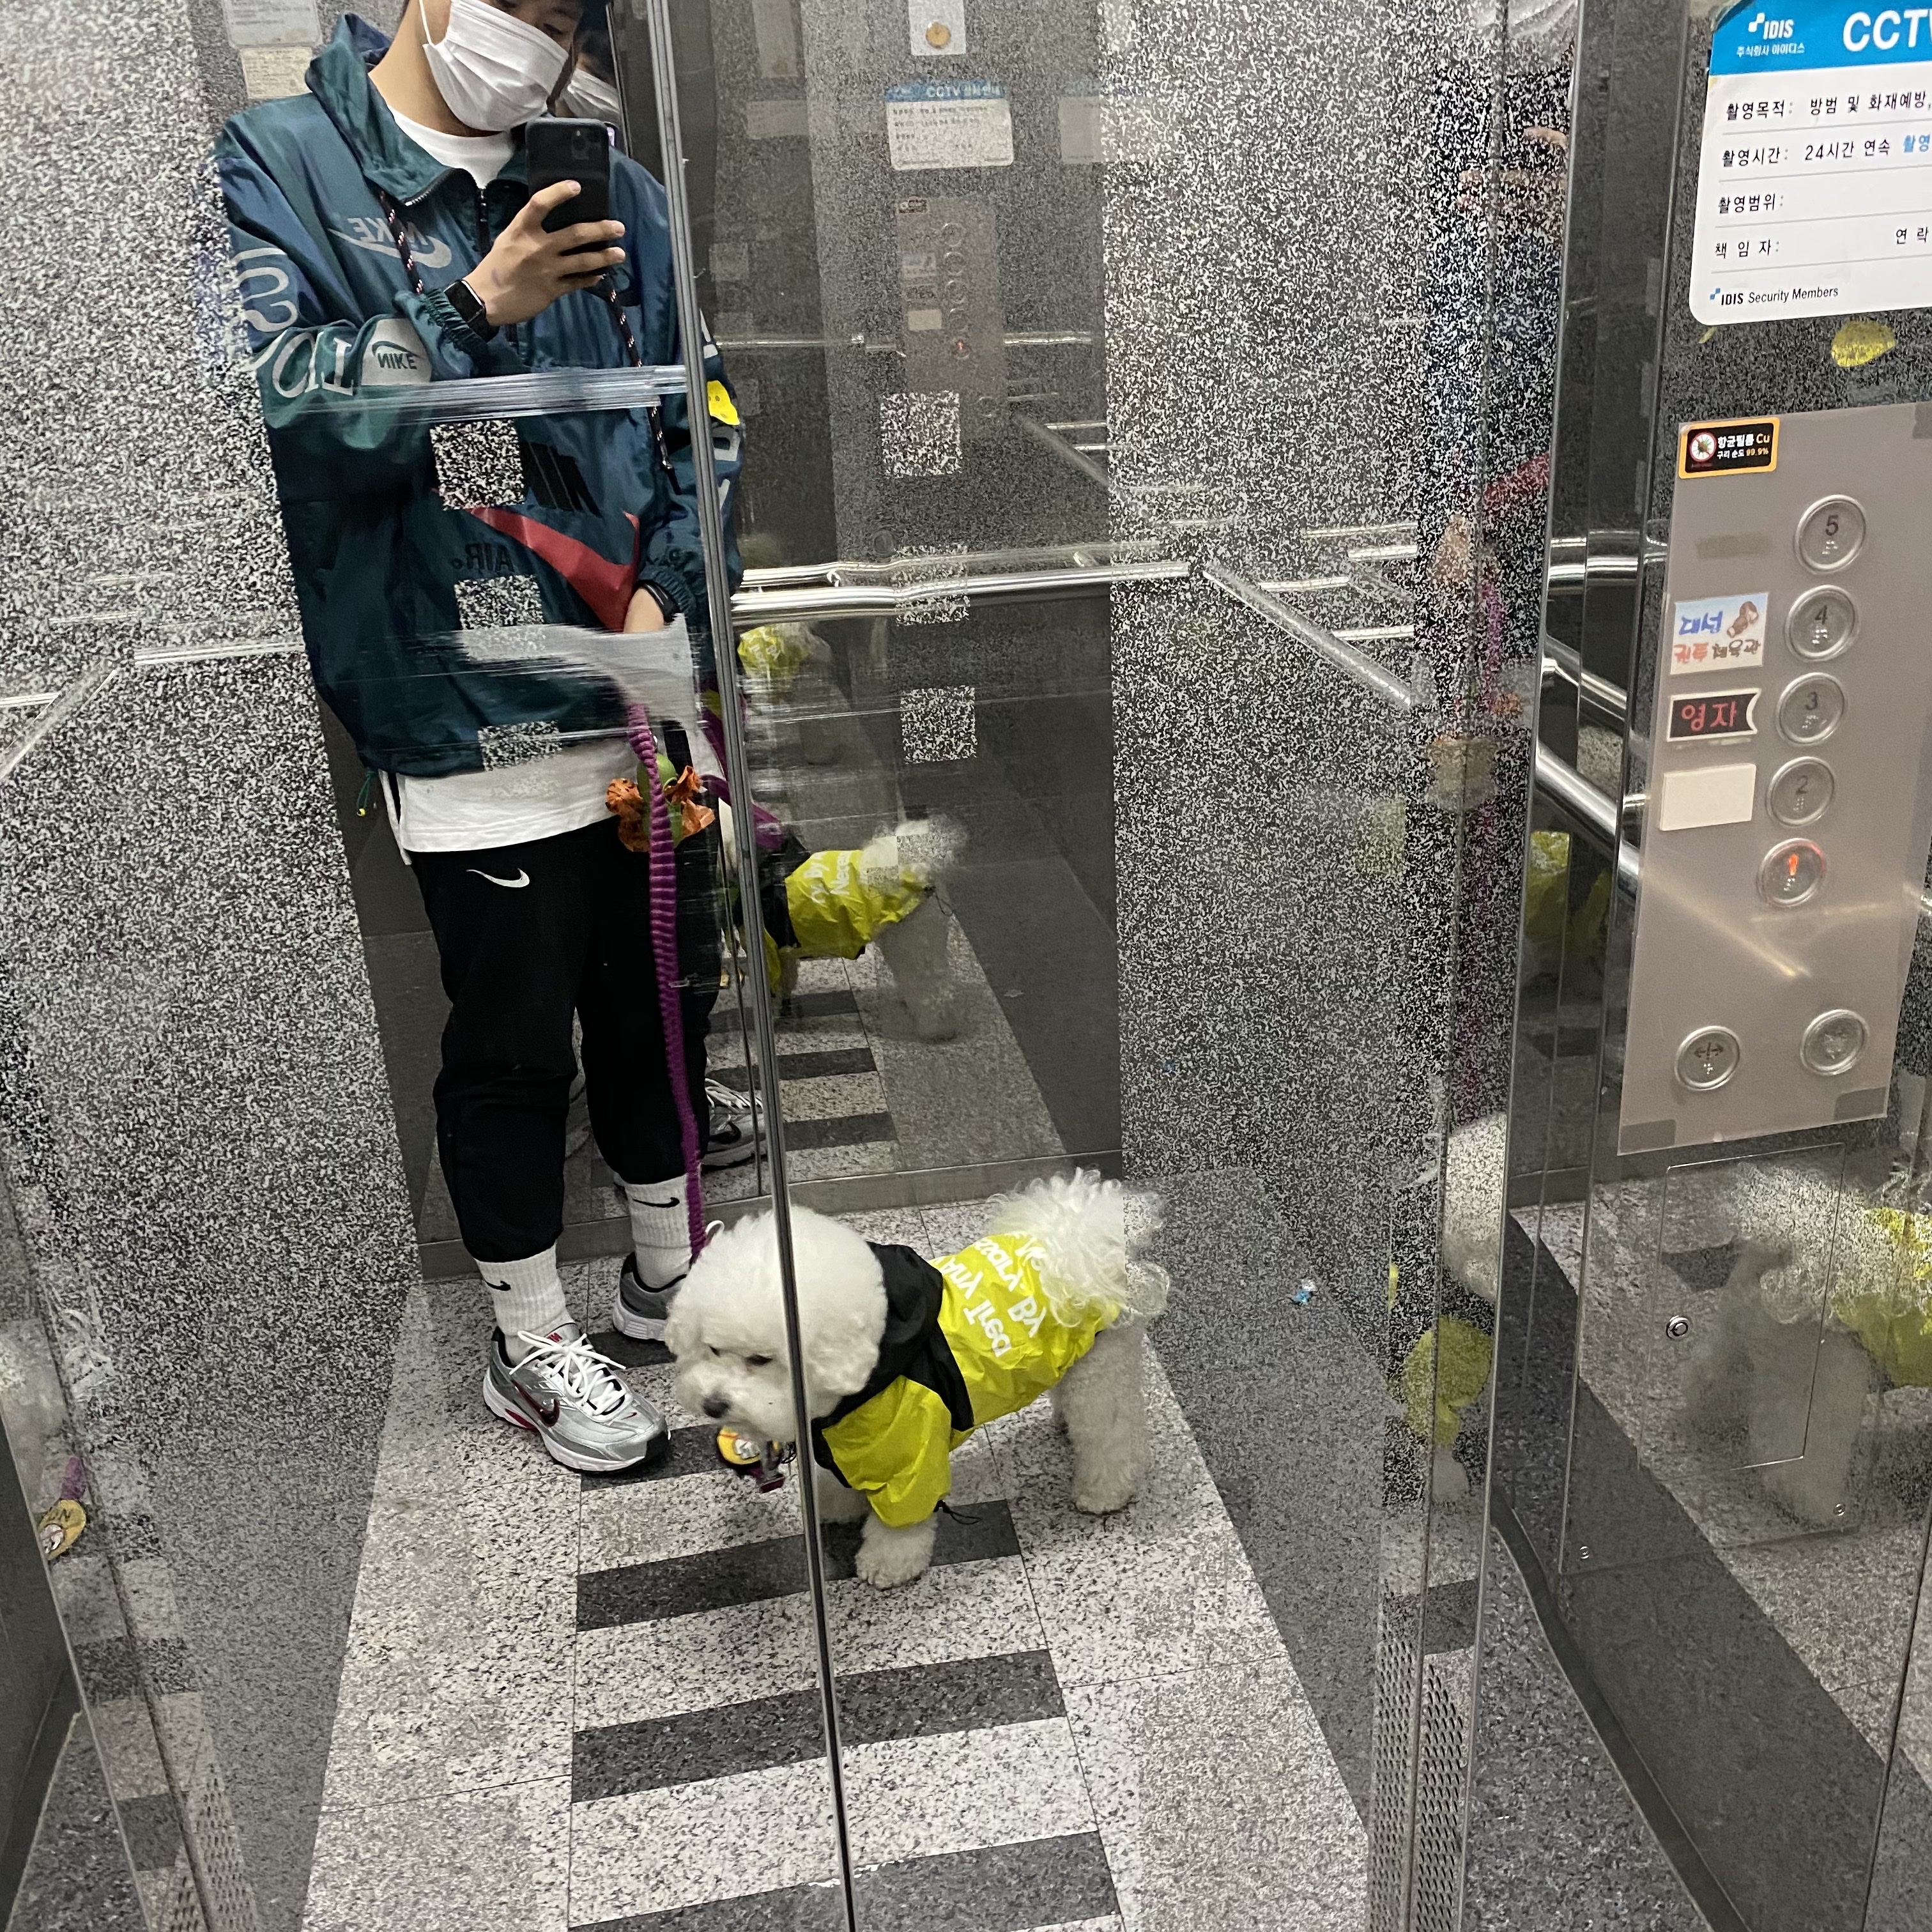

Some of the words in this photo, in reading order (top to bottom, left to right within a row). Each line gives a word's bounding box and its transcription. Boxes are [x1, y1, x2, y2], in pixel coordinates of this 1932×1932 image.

[1763, 19, 1794, 40] IDIS
[1843, 8, 1932, 52] CCT
[1736, 44, 1770, 57] 주식회사
[1772, 42, 1805, 55] 아이디스
[1810, 96, 1837, 116] 방범
[1848, 94, 1860, 113] 및
[1805, 141, 1854, 161] 24시간
[1864, 138, 1890, 155] 연속
[1721, 293, 1744, 305] IDIS
[1748, 289, 1790, 303] Security
[1792, 286, 1839, 300] Members
[1756, 433, 1770, 444] Cu
[1824, 514, 1839, 537] 5
[1814, 604, 1828, 625] 4
[1805, 691, 1820, 711] 3
[1681, 700, 1737, 732] 영자
[1795, 775, 1808, 795] 2
